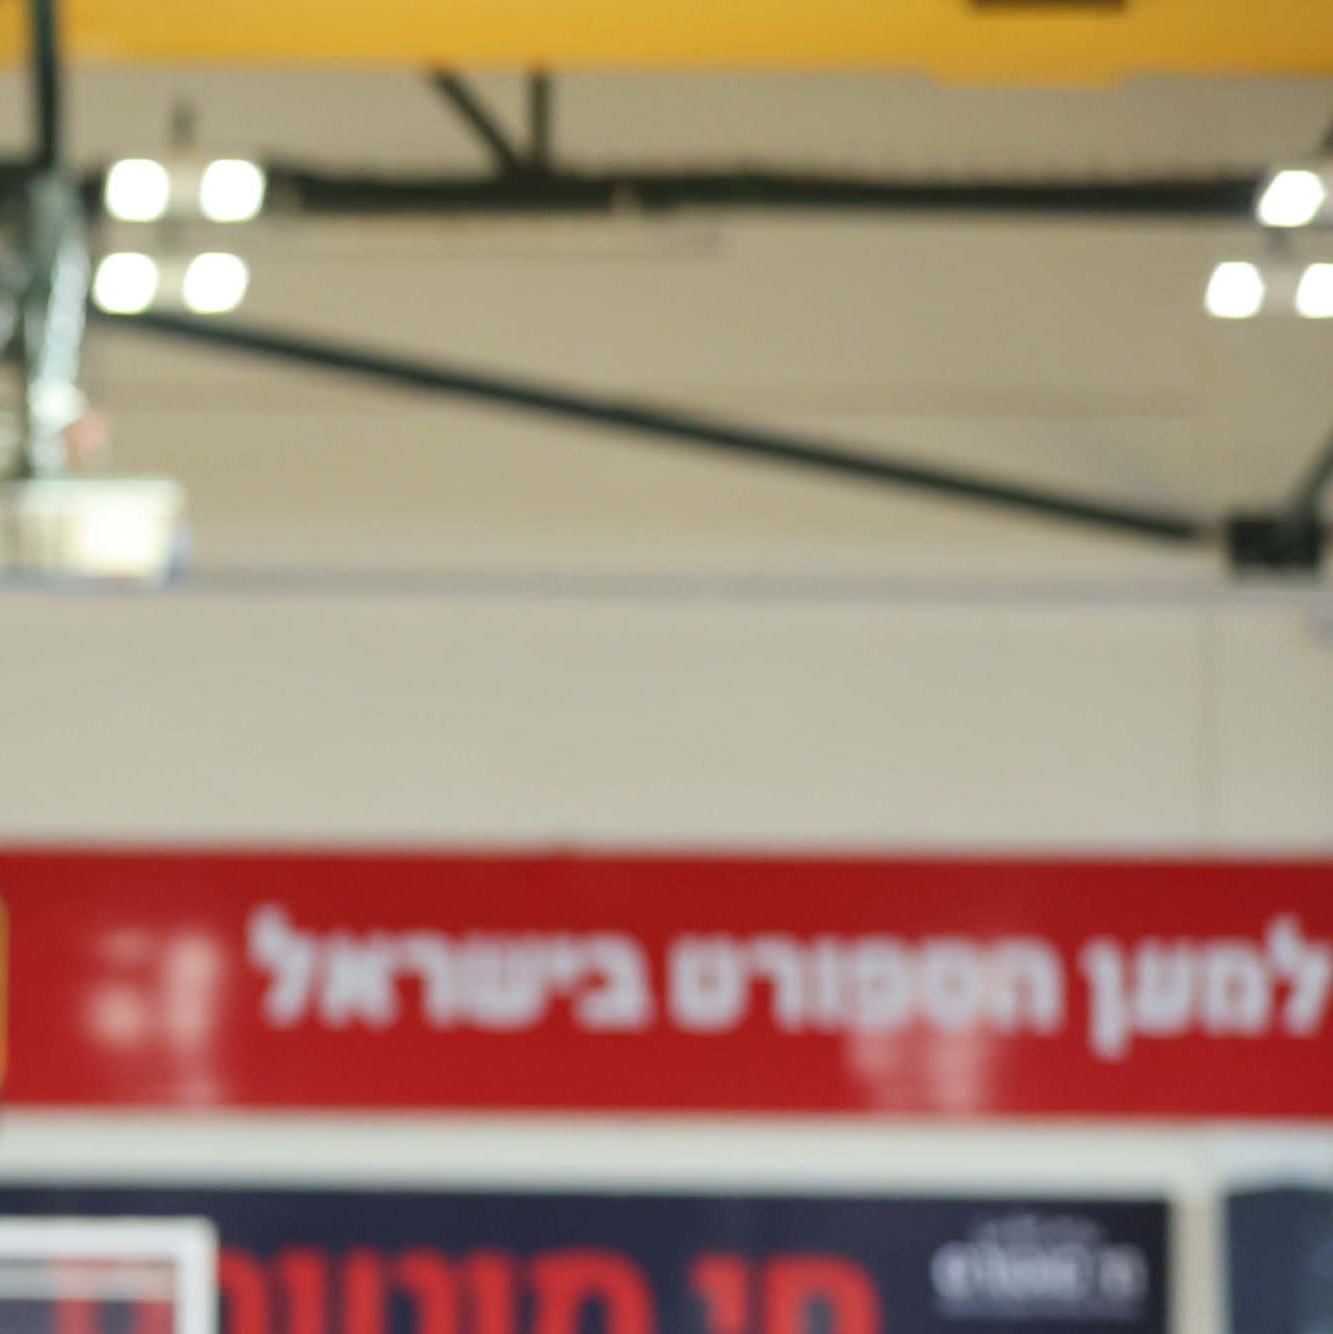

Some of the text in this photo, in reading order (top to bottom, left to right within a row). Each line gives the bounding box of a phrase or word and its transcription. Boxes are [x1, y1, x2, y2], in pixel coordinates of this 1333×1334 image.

[246, 900, 1333, 1062] למען הספורט בישראל
